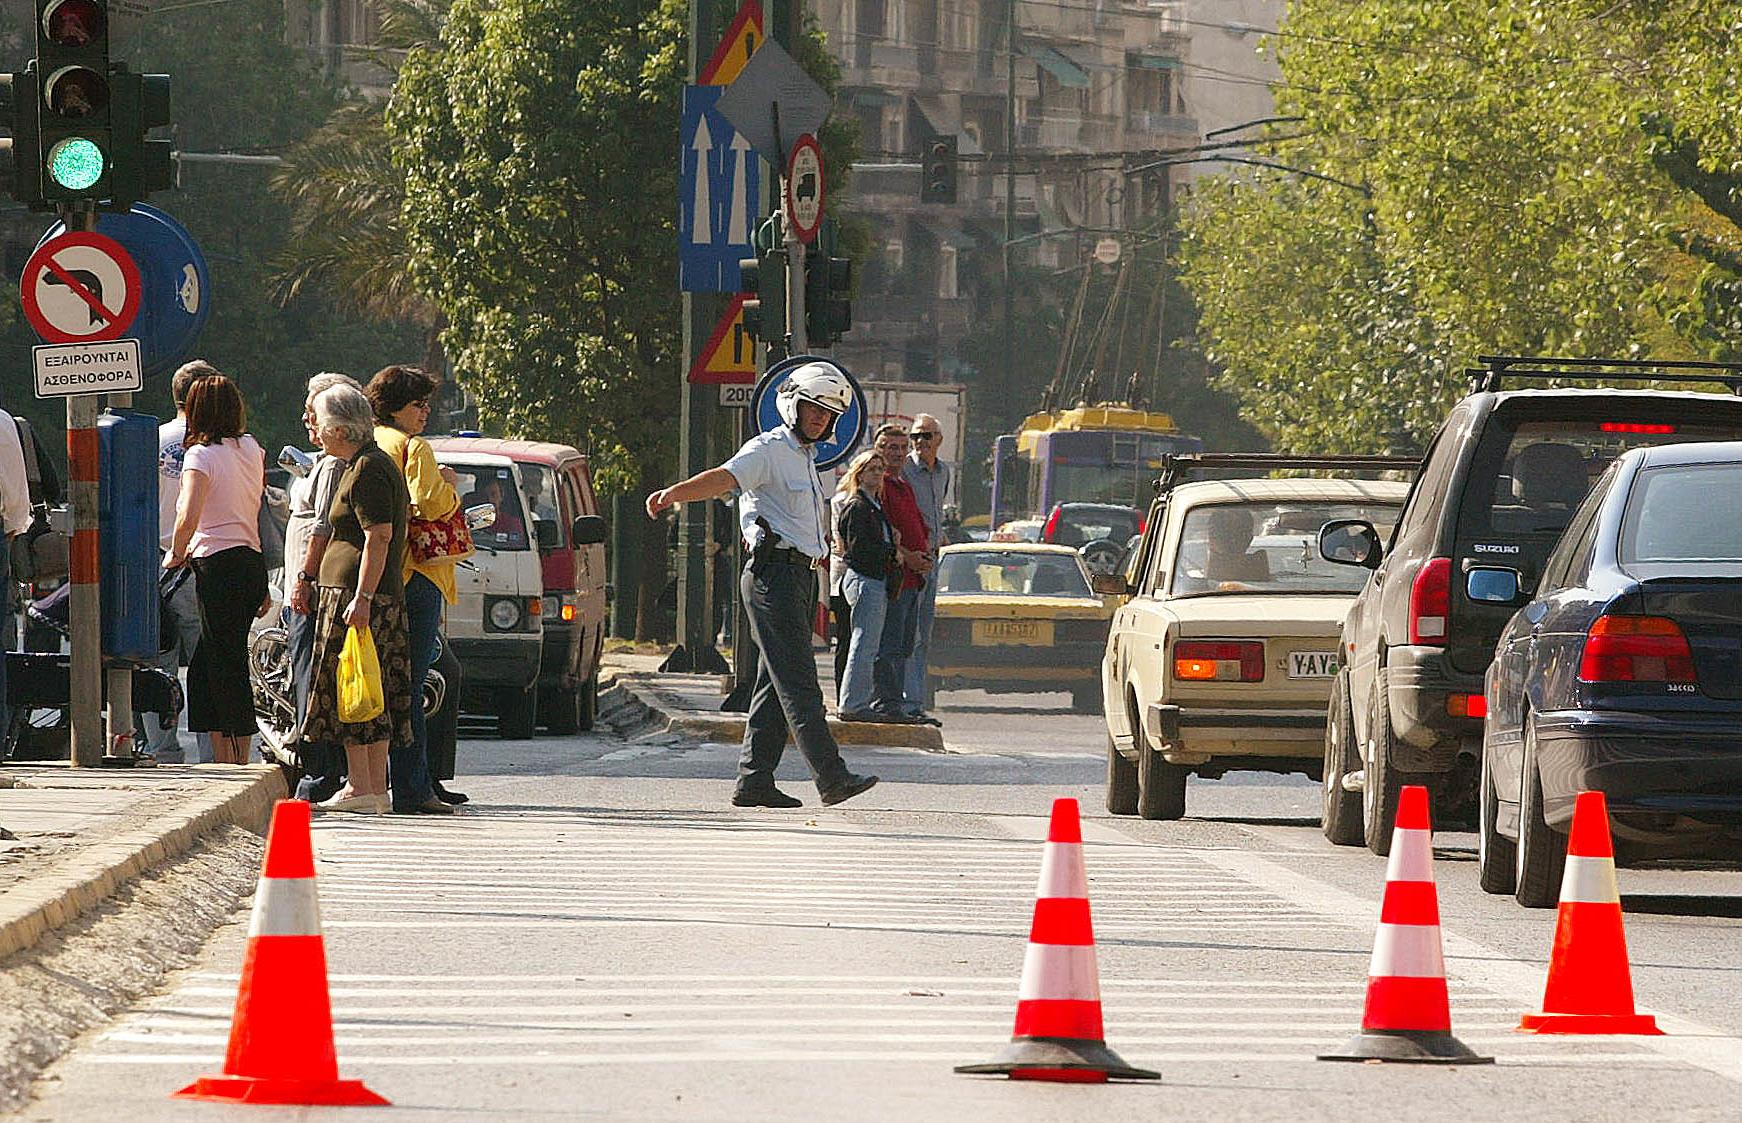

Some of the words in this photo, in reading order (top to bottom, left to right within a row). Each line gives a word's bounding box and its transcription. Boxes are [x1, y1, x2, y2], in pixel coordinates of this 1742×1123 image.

[44, 351, 129, 367] ΕΞΑΙΡΟΥΝΤΑΙ
[43, 370, 133, 386] ΑΣΘΕΝΟΦΟΡΑ
[1473, 544, 1520, 553] SUZUKI
